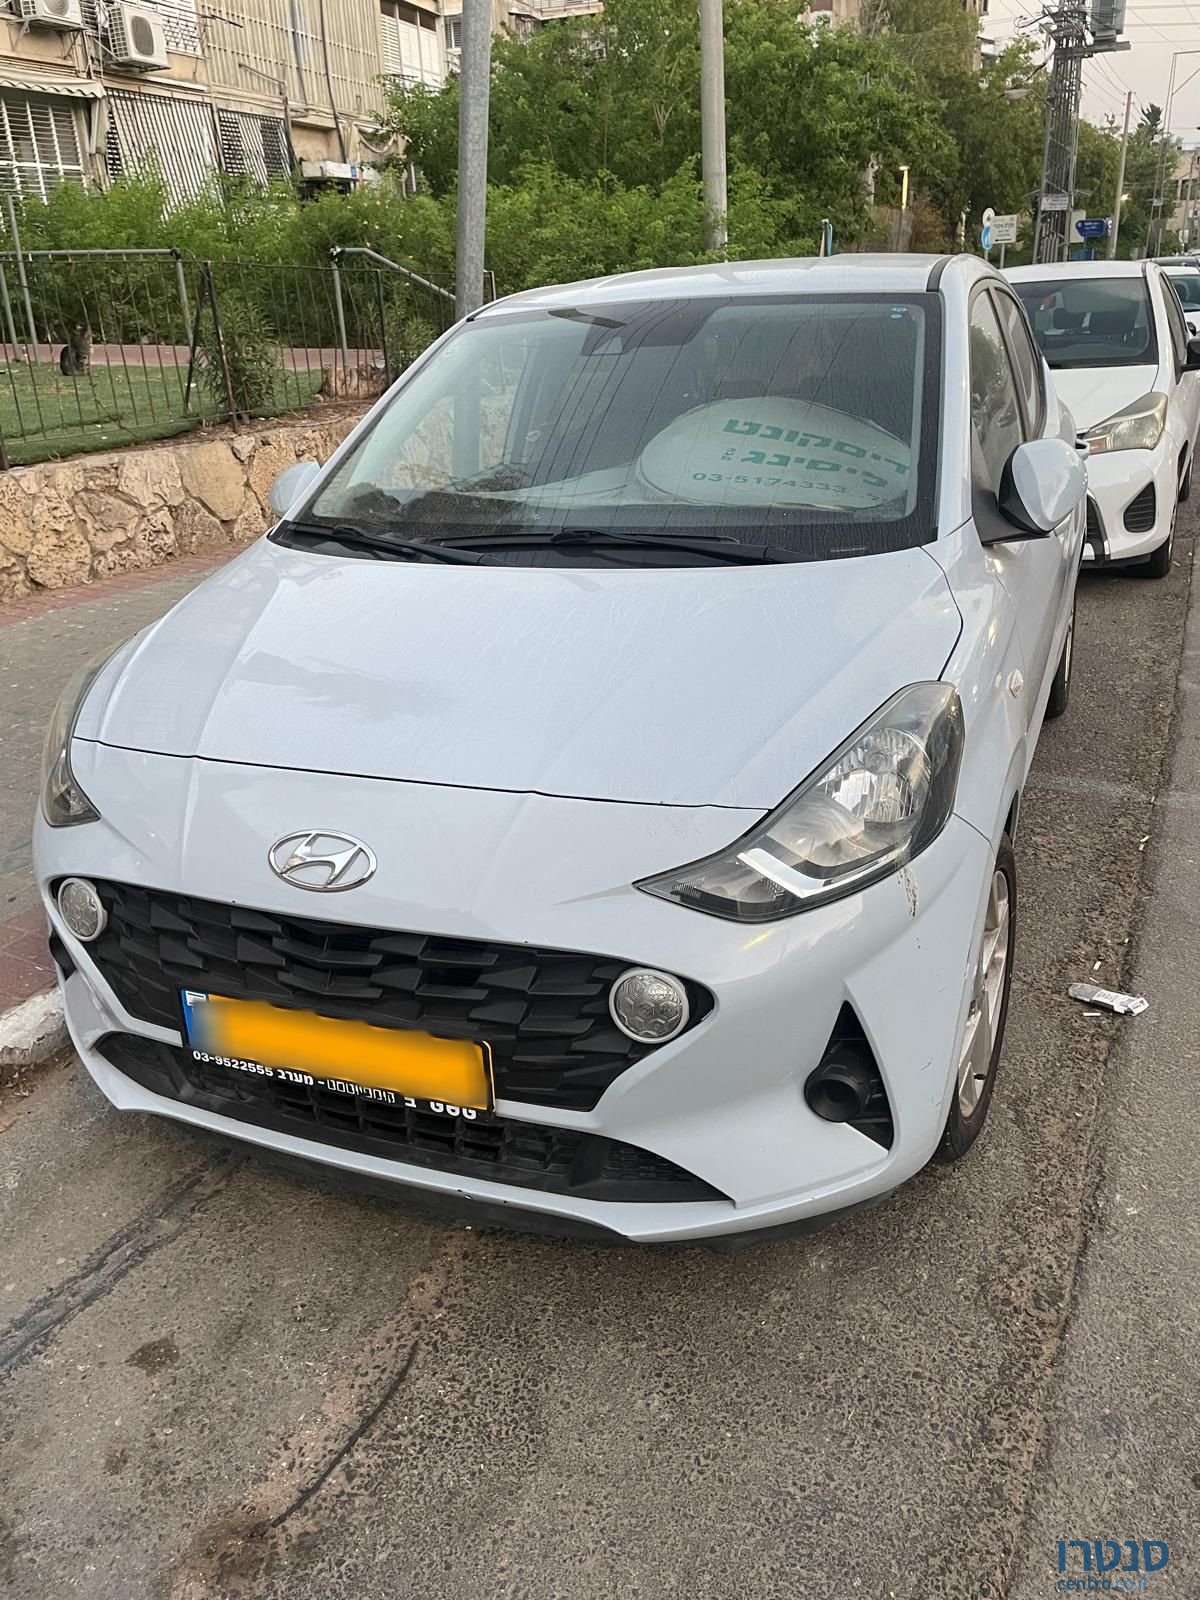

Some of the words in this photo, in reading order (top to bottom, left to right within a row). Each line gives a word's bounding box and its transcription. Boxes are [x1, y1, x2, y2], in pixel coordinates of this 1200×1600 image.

[723, 418, 910, 474] דיסקונט
[692, 472, 847, 493] 03-5174333
[193, 1050, 273, 1077] 03-9522555
[277, 1069, 314, 1086] מערב
[326, 1078, 395, 1104] קומפיוטסט
